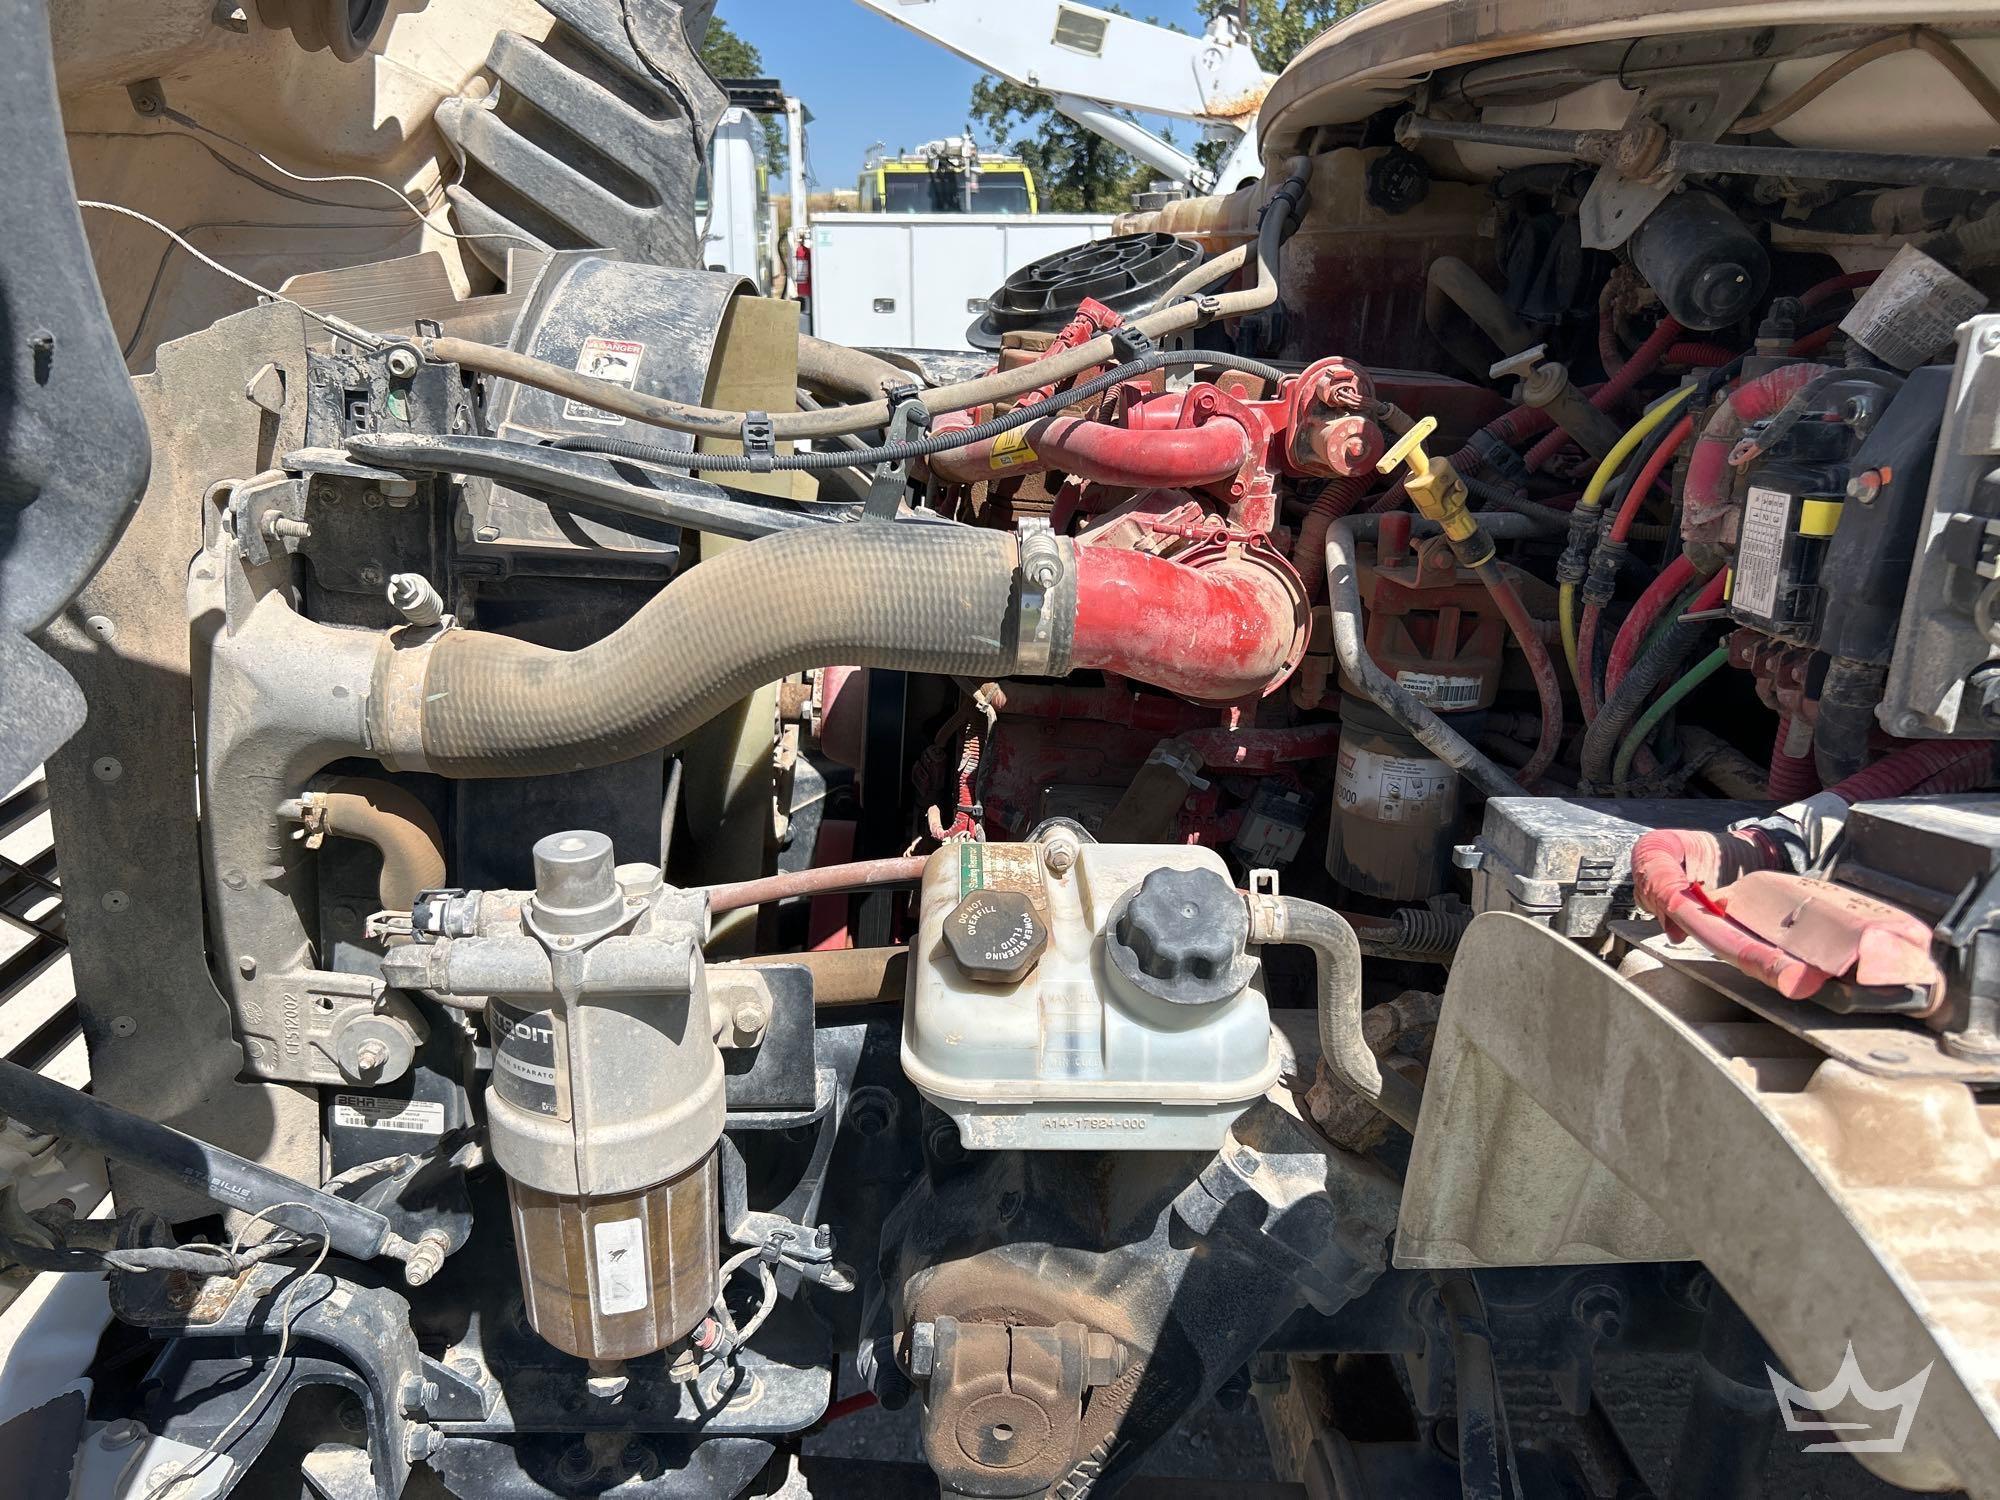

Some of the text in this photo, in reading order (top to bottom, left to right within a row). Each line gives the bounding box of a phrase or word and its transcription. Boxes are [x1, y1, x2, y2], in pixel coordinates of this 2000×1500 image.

[958, 899, 983, 925] DO NOT
[967, 905, 997, 936] OVERFILL
[985, 912, 1033, 961] POWER STEERING
[1000, 927, 1023, 950] FLUID
[490, 1010, 554, 1044] ETROIT
[513, 1063, 555, 1080] SEPARATO
[338, 1095, 376, 1108] BEHR
